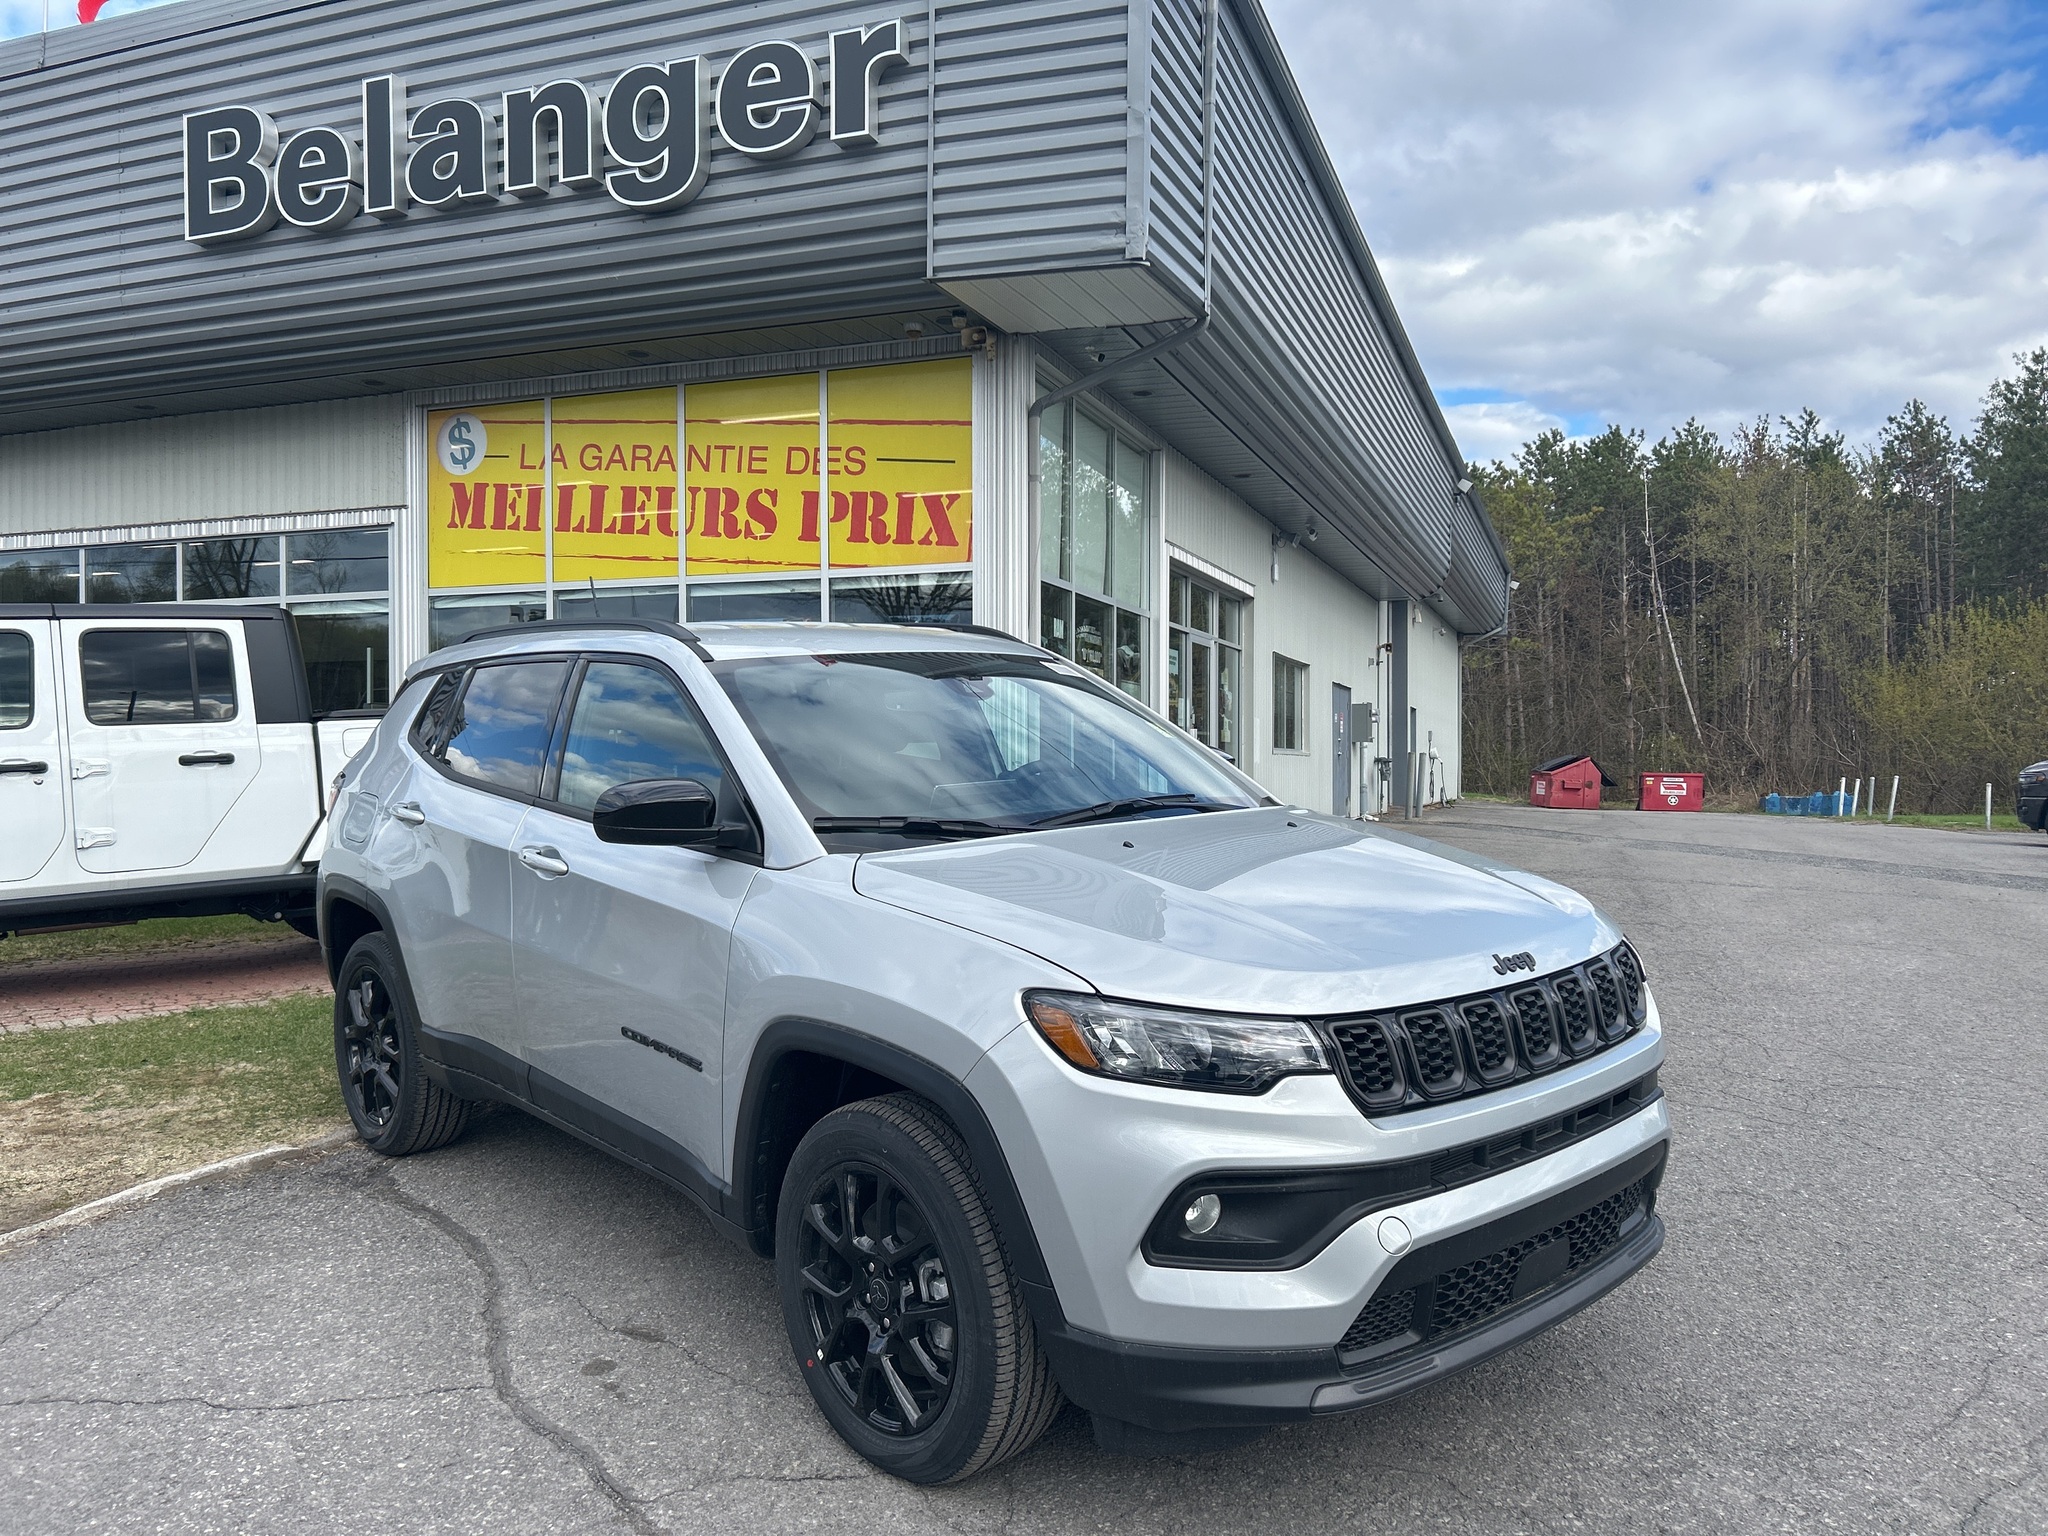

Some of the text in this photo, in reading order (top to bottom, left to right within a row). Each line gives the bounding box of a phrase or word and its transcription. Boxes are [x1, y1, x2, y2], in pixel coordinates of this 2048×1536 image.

[183, 18, 905, 245] Belanger
[519, 443, 867, 476] LA GARANTIE DES
[447, 482, 961, 548] MEILLEURS PRIX
[1492, 951, 1536, 976] Jeep
